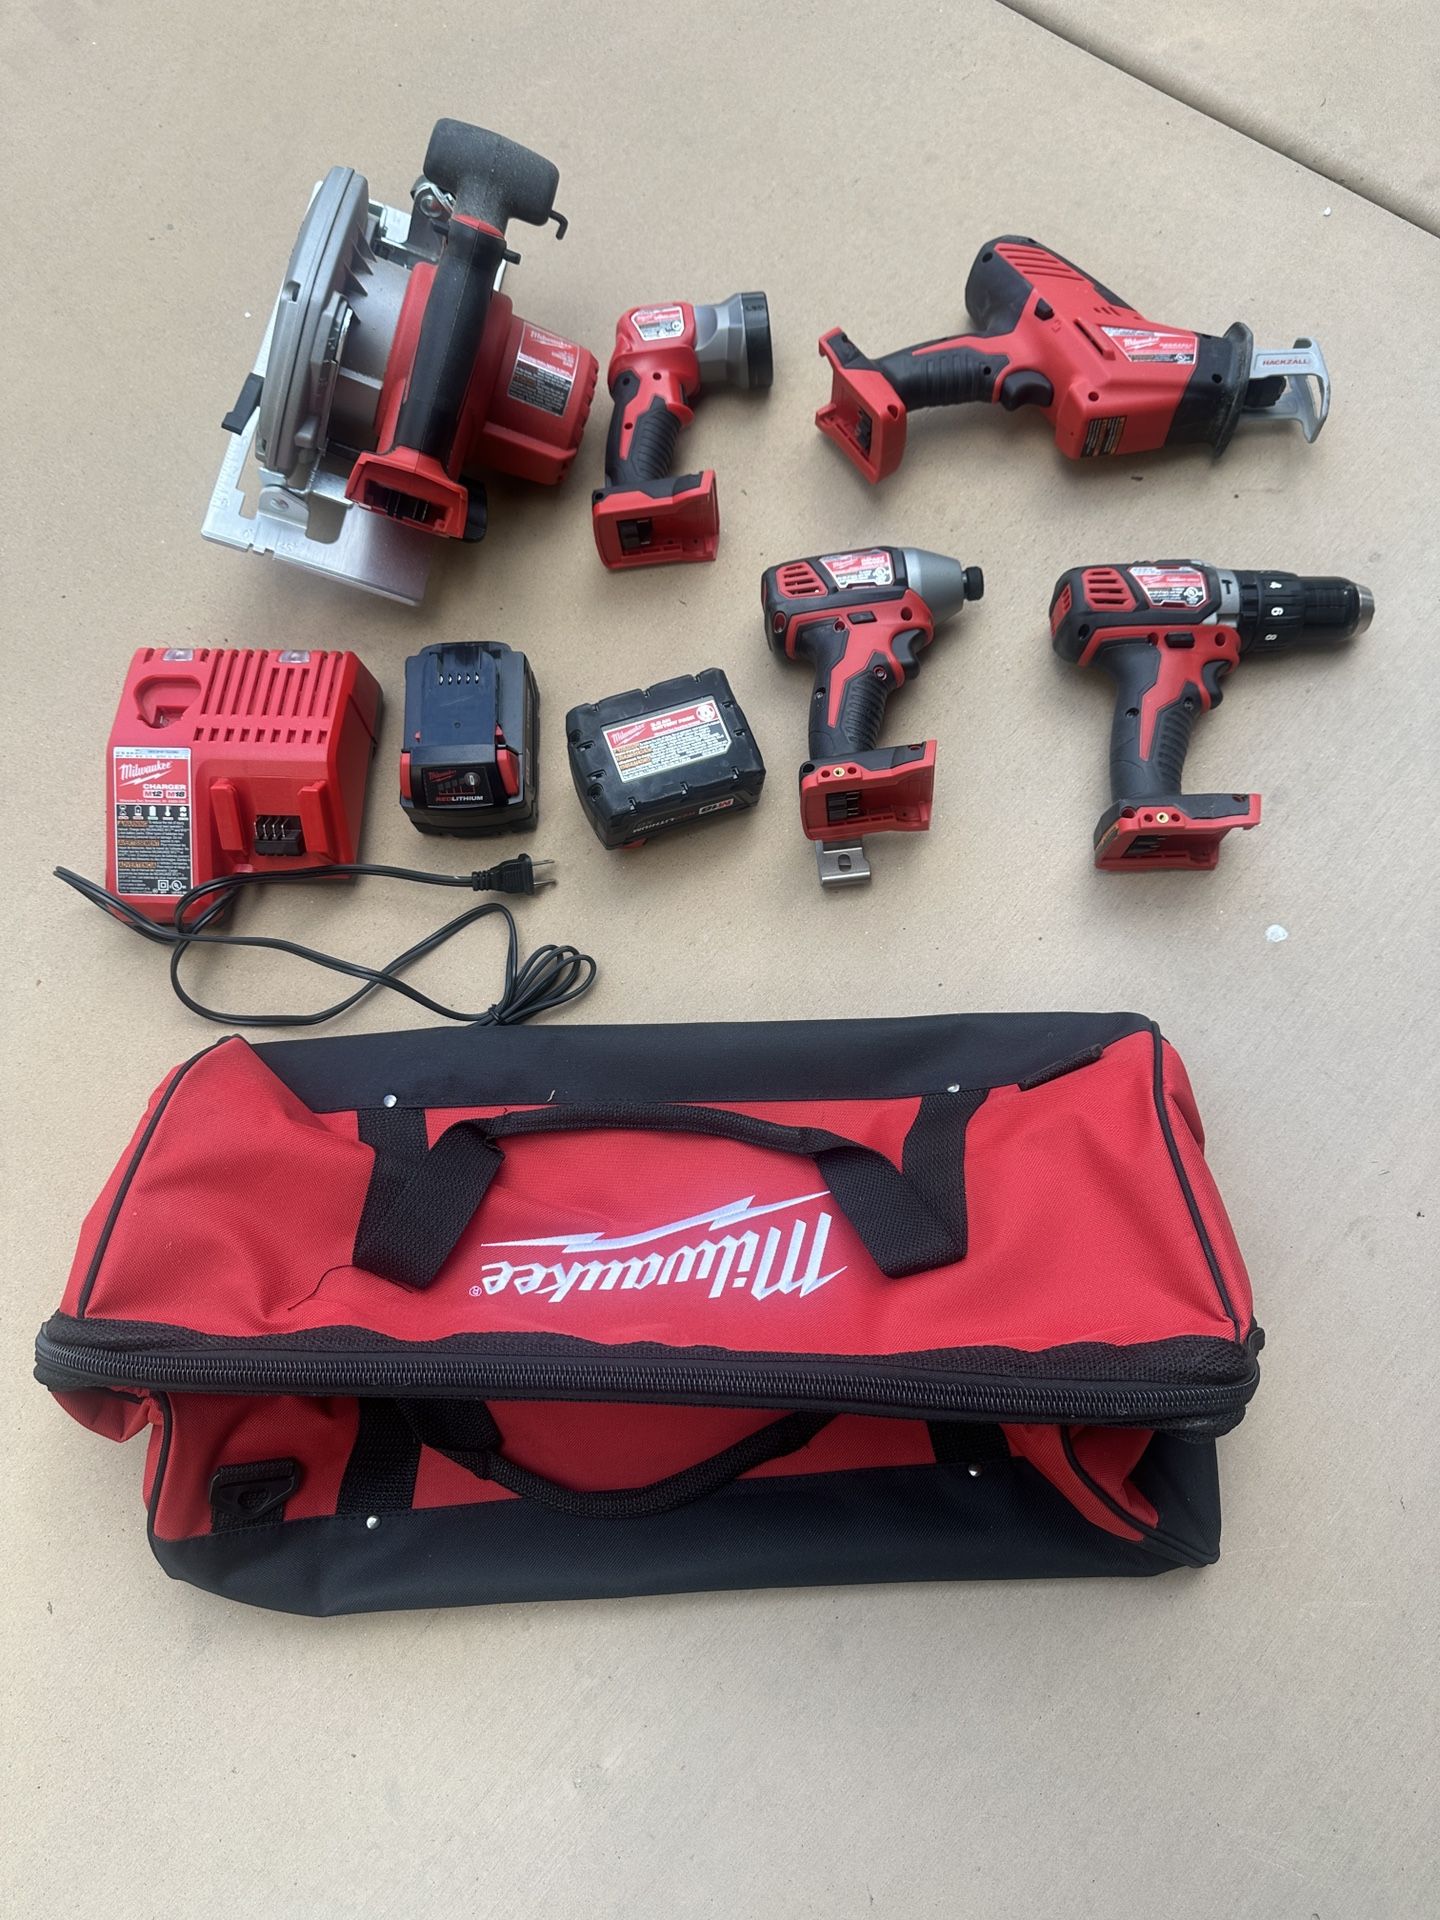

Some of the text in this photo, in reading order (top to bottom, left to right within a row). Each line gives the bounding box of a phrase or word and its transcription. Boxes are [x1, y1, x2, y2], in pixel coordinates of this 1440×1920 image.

[1269, 581, 1283, 589] 4
[1270, 606, 1284, 616] 6
[1265, 633, 1278, 641] 8
[118, 761, 171, 781] Milwaukee
